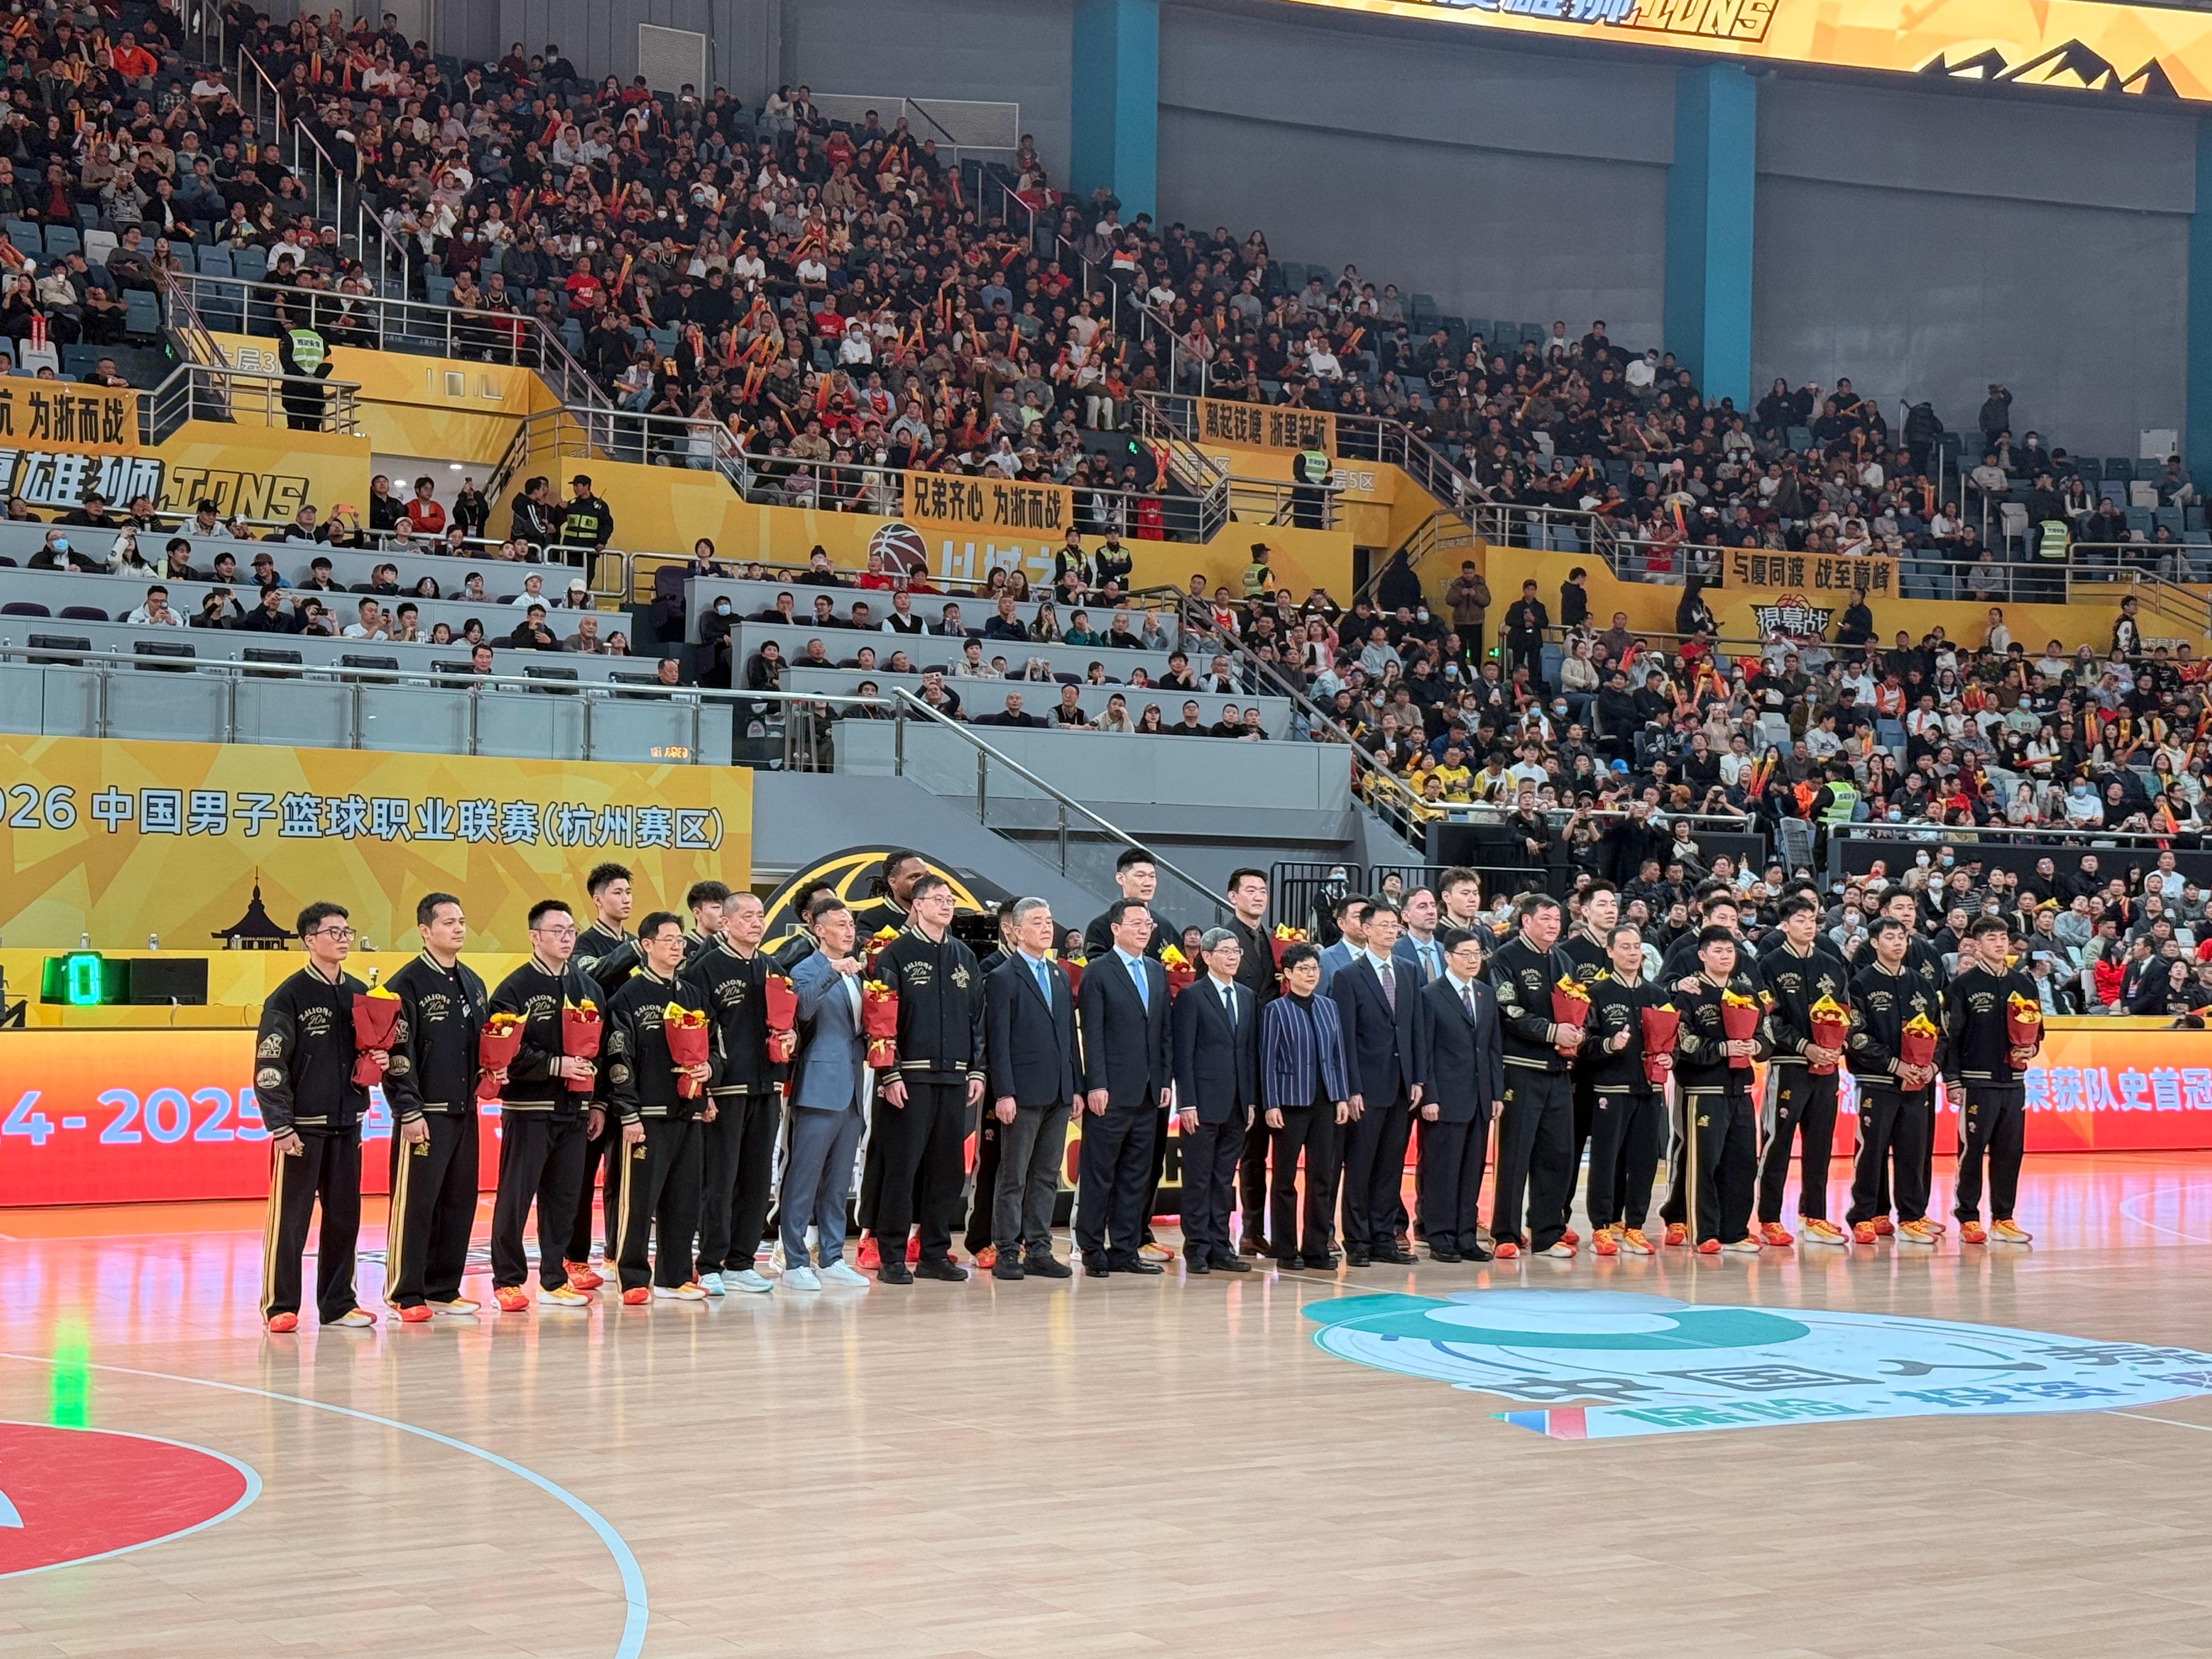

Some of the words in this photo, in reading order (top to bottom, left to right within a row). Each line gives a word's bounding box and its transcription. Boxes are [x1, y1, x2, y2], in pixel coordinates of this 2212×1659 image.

[213, 344, 284, 375] 上层3
[29, 391, 124, 445] 为浙而战
[914, 477, 984, 522] 兄弟齐心
[994, 484, 1062, 531] 为浙而战
[1733, 551, 1804, 588] 与厦同渡
[1815, 557, 1890, 592] 战至巅峰
[0, 785, 76, 831] 26
